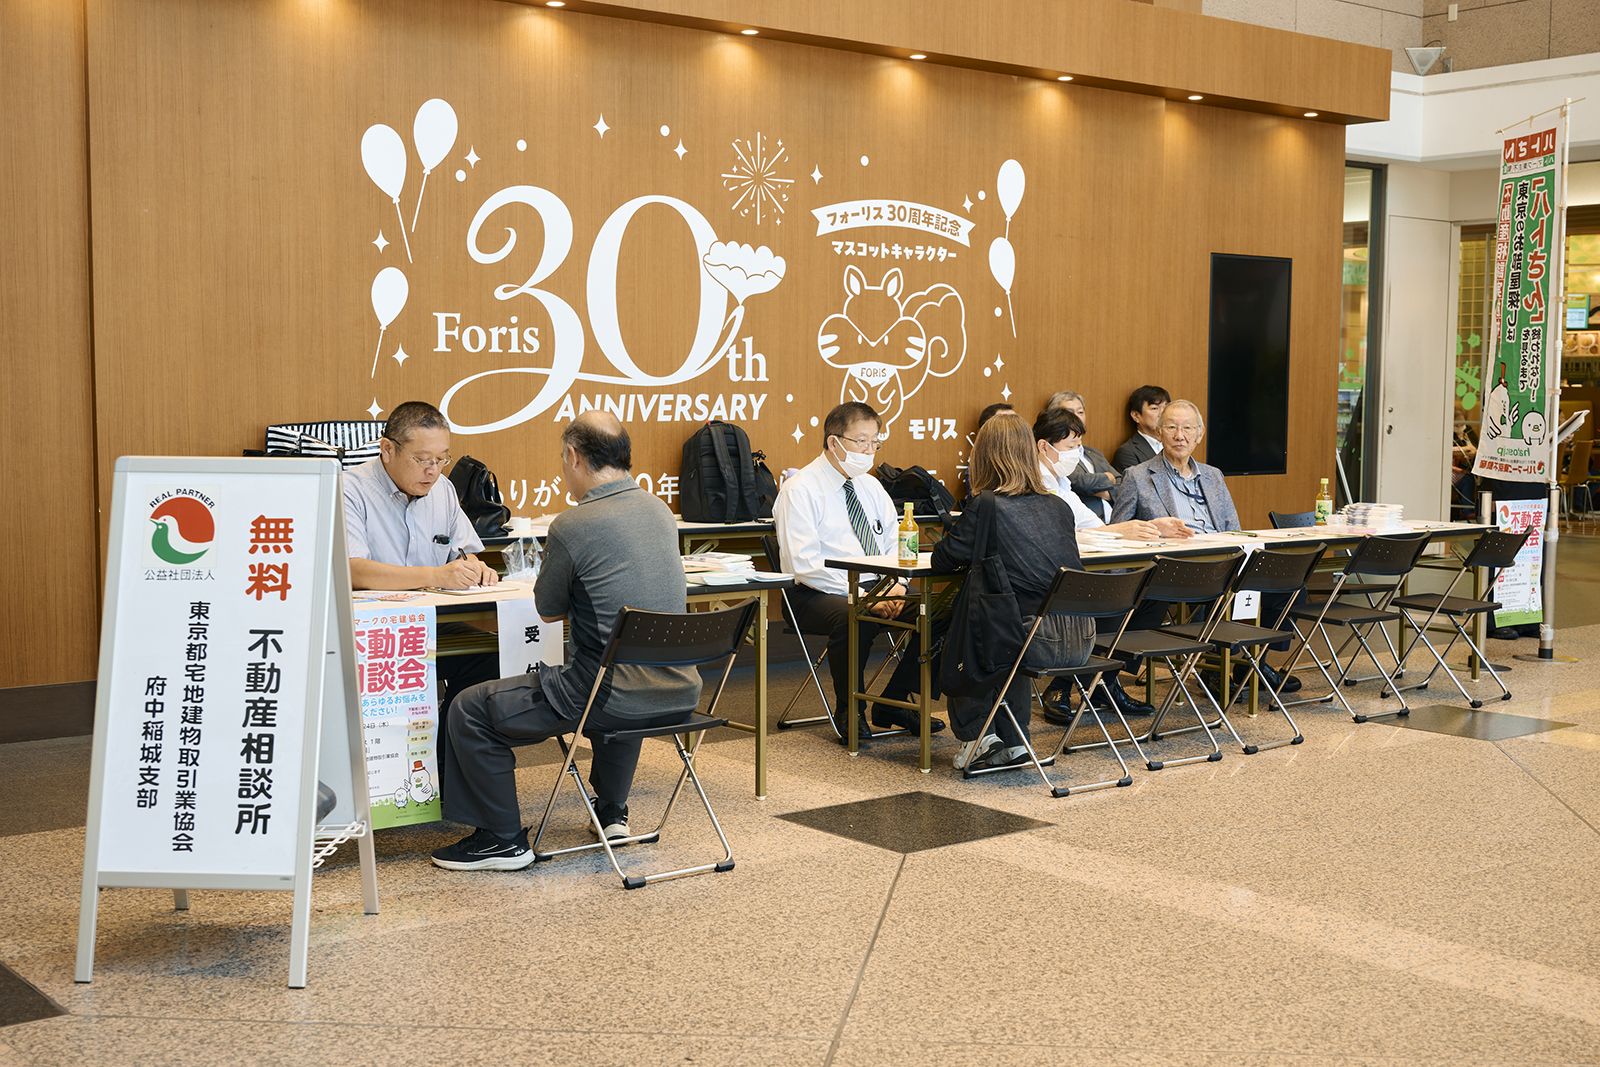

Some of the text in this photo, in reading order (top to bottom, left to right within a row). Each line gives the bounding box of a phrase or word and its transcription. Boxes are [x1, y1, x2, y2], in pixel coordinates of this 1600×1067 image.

[826, 203, 962, 237] フォーリス30周年記念
[831, 240, 957, 263] マスコットキャラクター
[433, 312, 540, 354] Foris
[553, 394, 768, 422] ANNIVERSARY
[908, 417, 958, 441] モリス
[149, 488, 216, 509] REAL PARTNER
[1510, 510, 1543, 529] 不動産
[144, 569, 215, 581] 公益社団法人
[234, 514, 294, 835] 無料 不動産相談所
[358, 658, 427, 693] 談会
[136, 675, 168, 809] 府中稲城支部
[172, 601, 211, 853] 東京都宅地建物取引業協会
